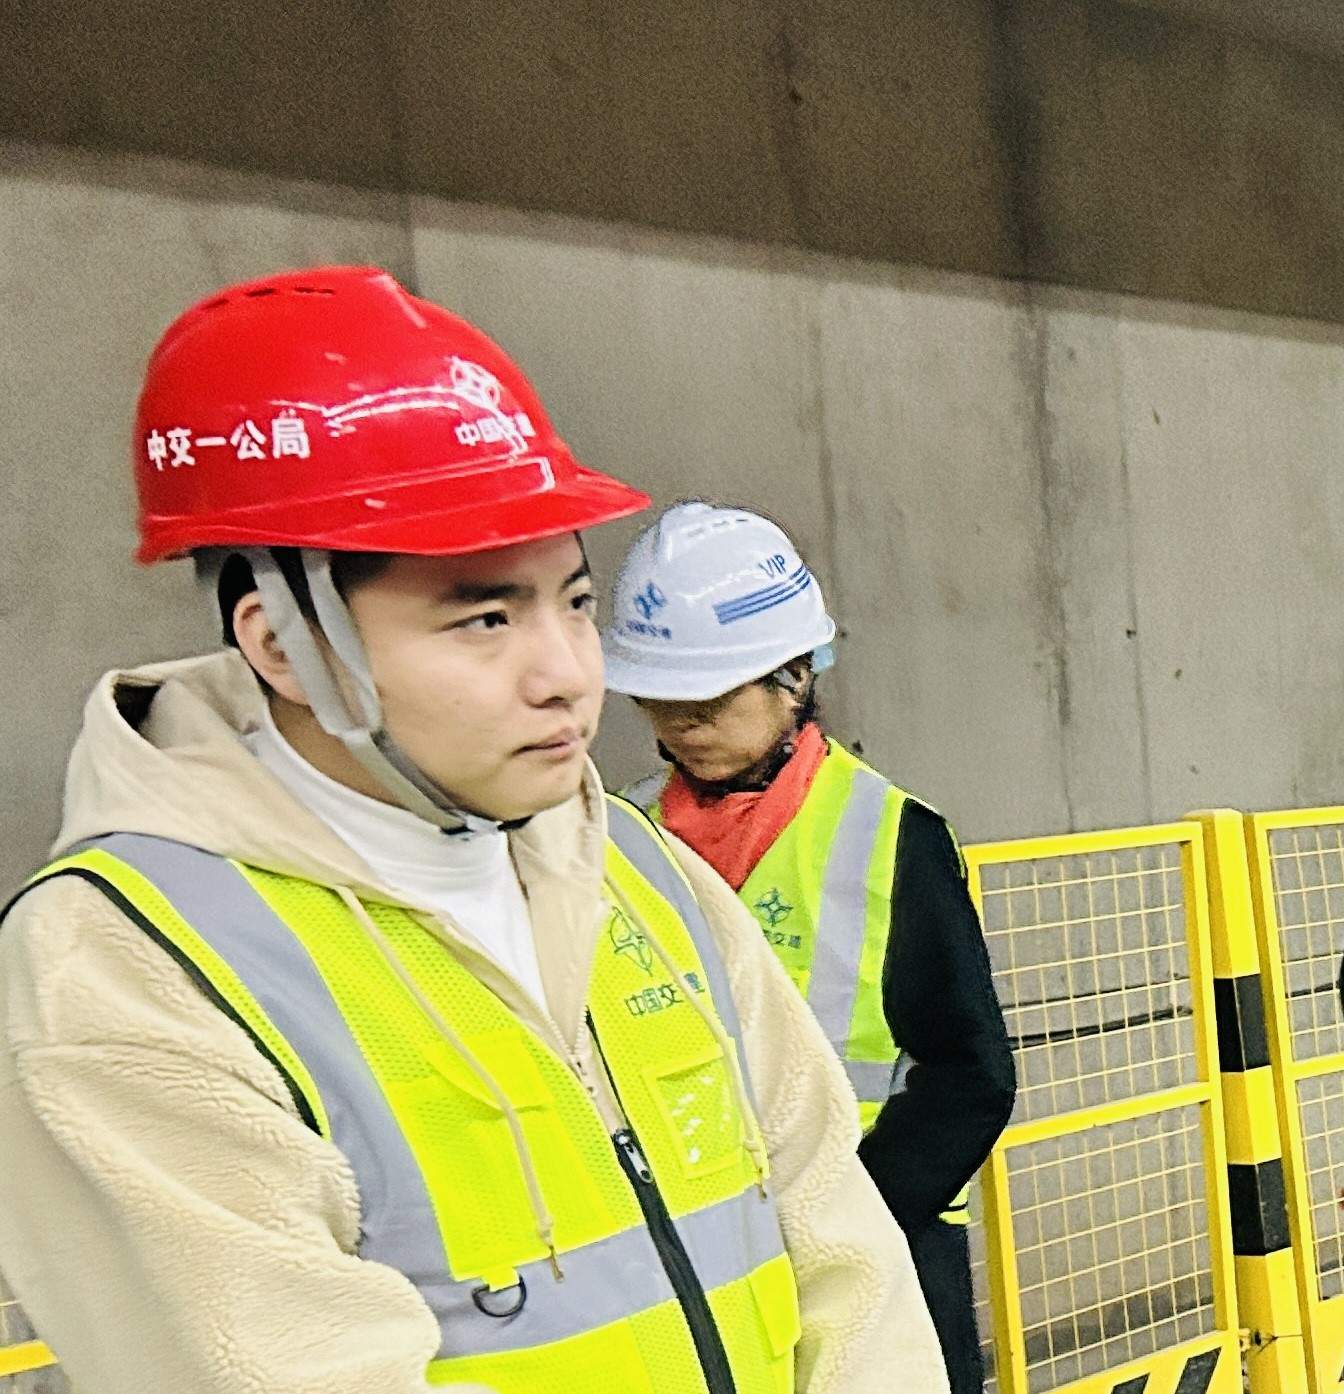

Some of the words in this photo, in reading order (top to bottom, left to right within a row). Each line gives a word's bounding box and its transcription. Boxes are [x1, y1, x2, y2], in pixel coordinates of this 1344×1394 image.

[147, 417, 310, 471] 中交一公局
[758, 554, 787, 579] VIP
